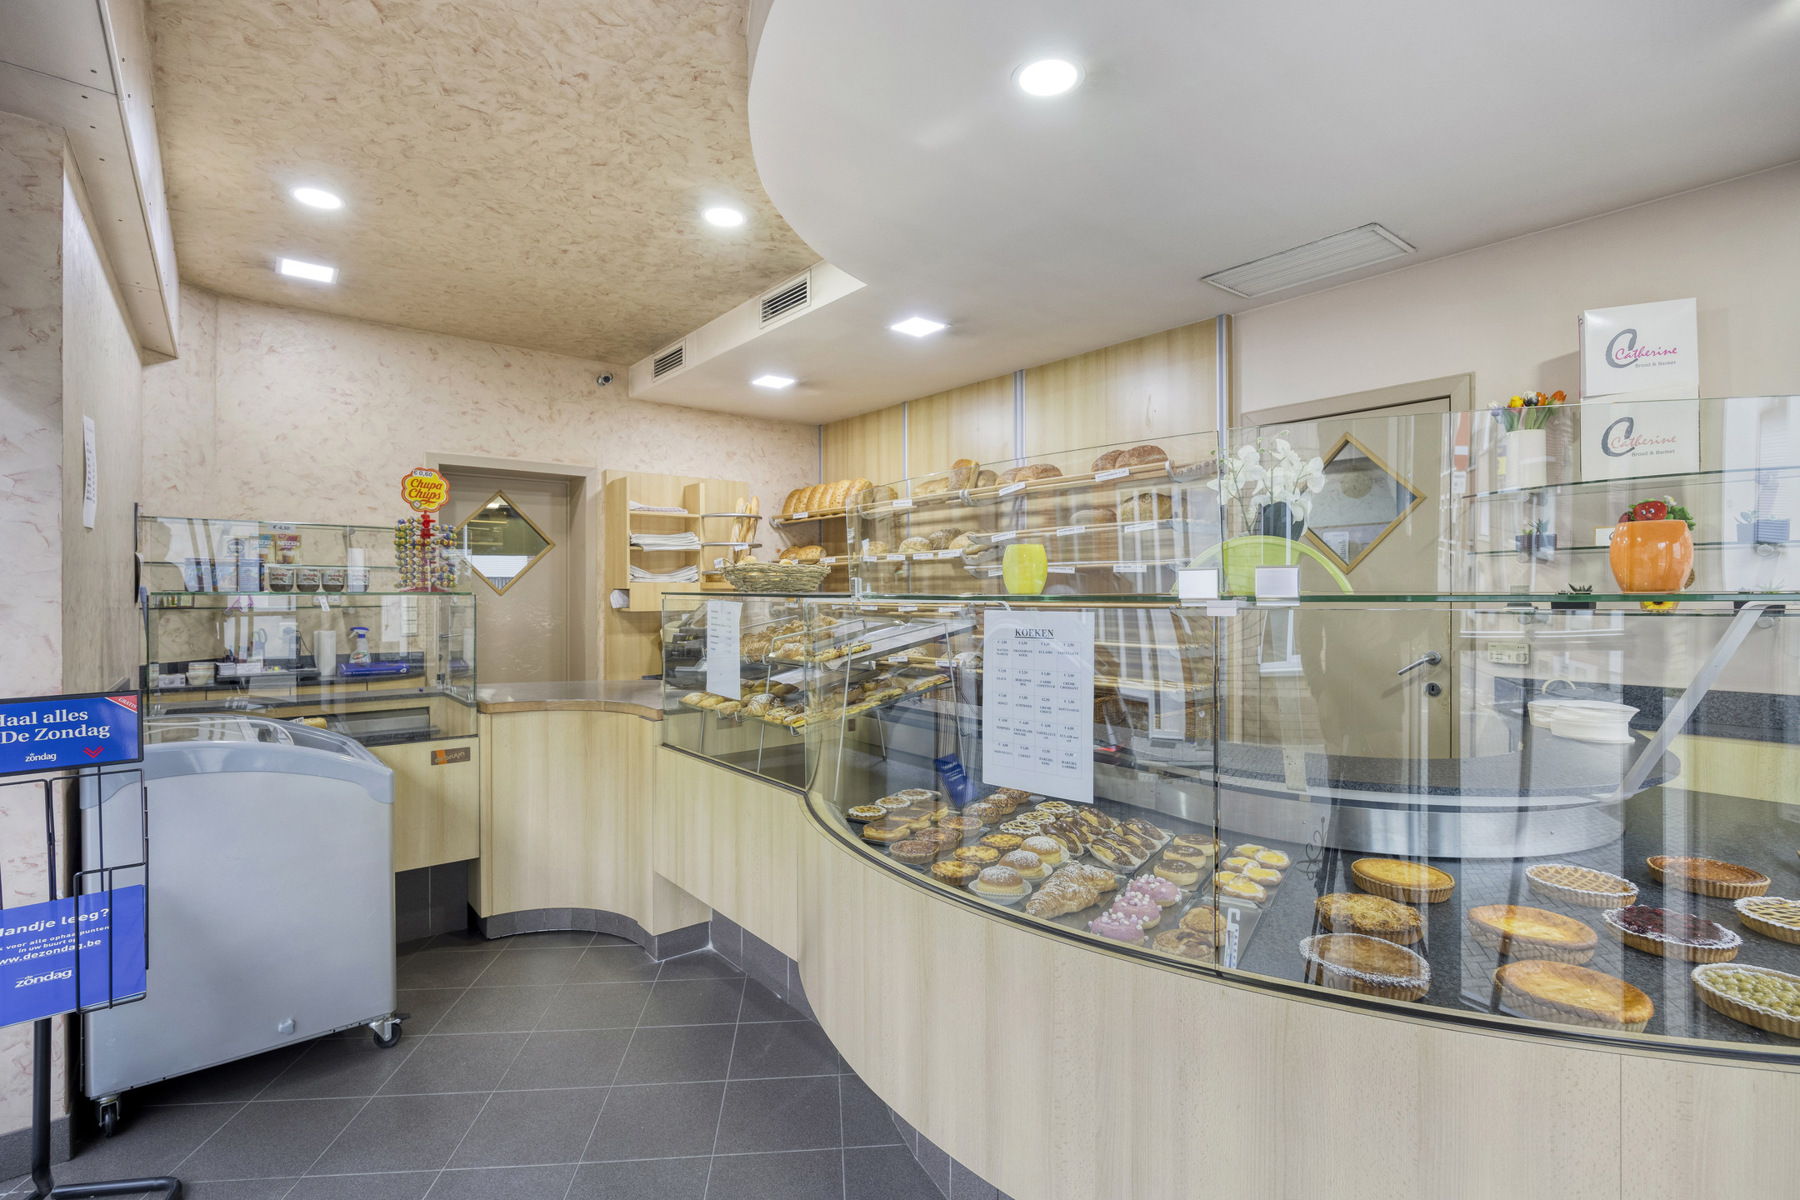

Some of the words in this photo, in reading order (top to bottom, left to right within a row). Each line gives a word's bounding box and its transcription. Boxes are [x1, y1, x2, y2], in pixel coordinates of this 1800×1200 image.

[1615, 346, 1678, 360] Catherine
[1611, 434, 1677, 449] Catherine
[410, 478, 443, 492] Chupa
[408, 488, 441, 503] Chups
[1015, 628, 1054, 638] KOEKEN
[118, 697, 138, 709] GRATIS
[43, 709, 89, 724] alles
[1, 730, 30, 745] De
[34, 724, 111, 742] Zondag
[61, 908, 109, 925] leeg?
[6, 942, 27, 950] voor
[29, 937, 47, 945] alle
[49, 926, 110, 942] ophaapunten
[43, 940, 66, 949] buurt
[14, 969, 73, 988] zondag
